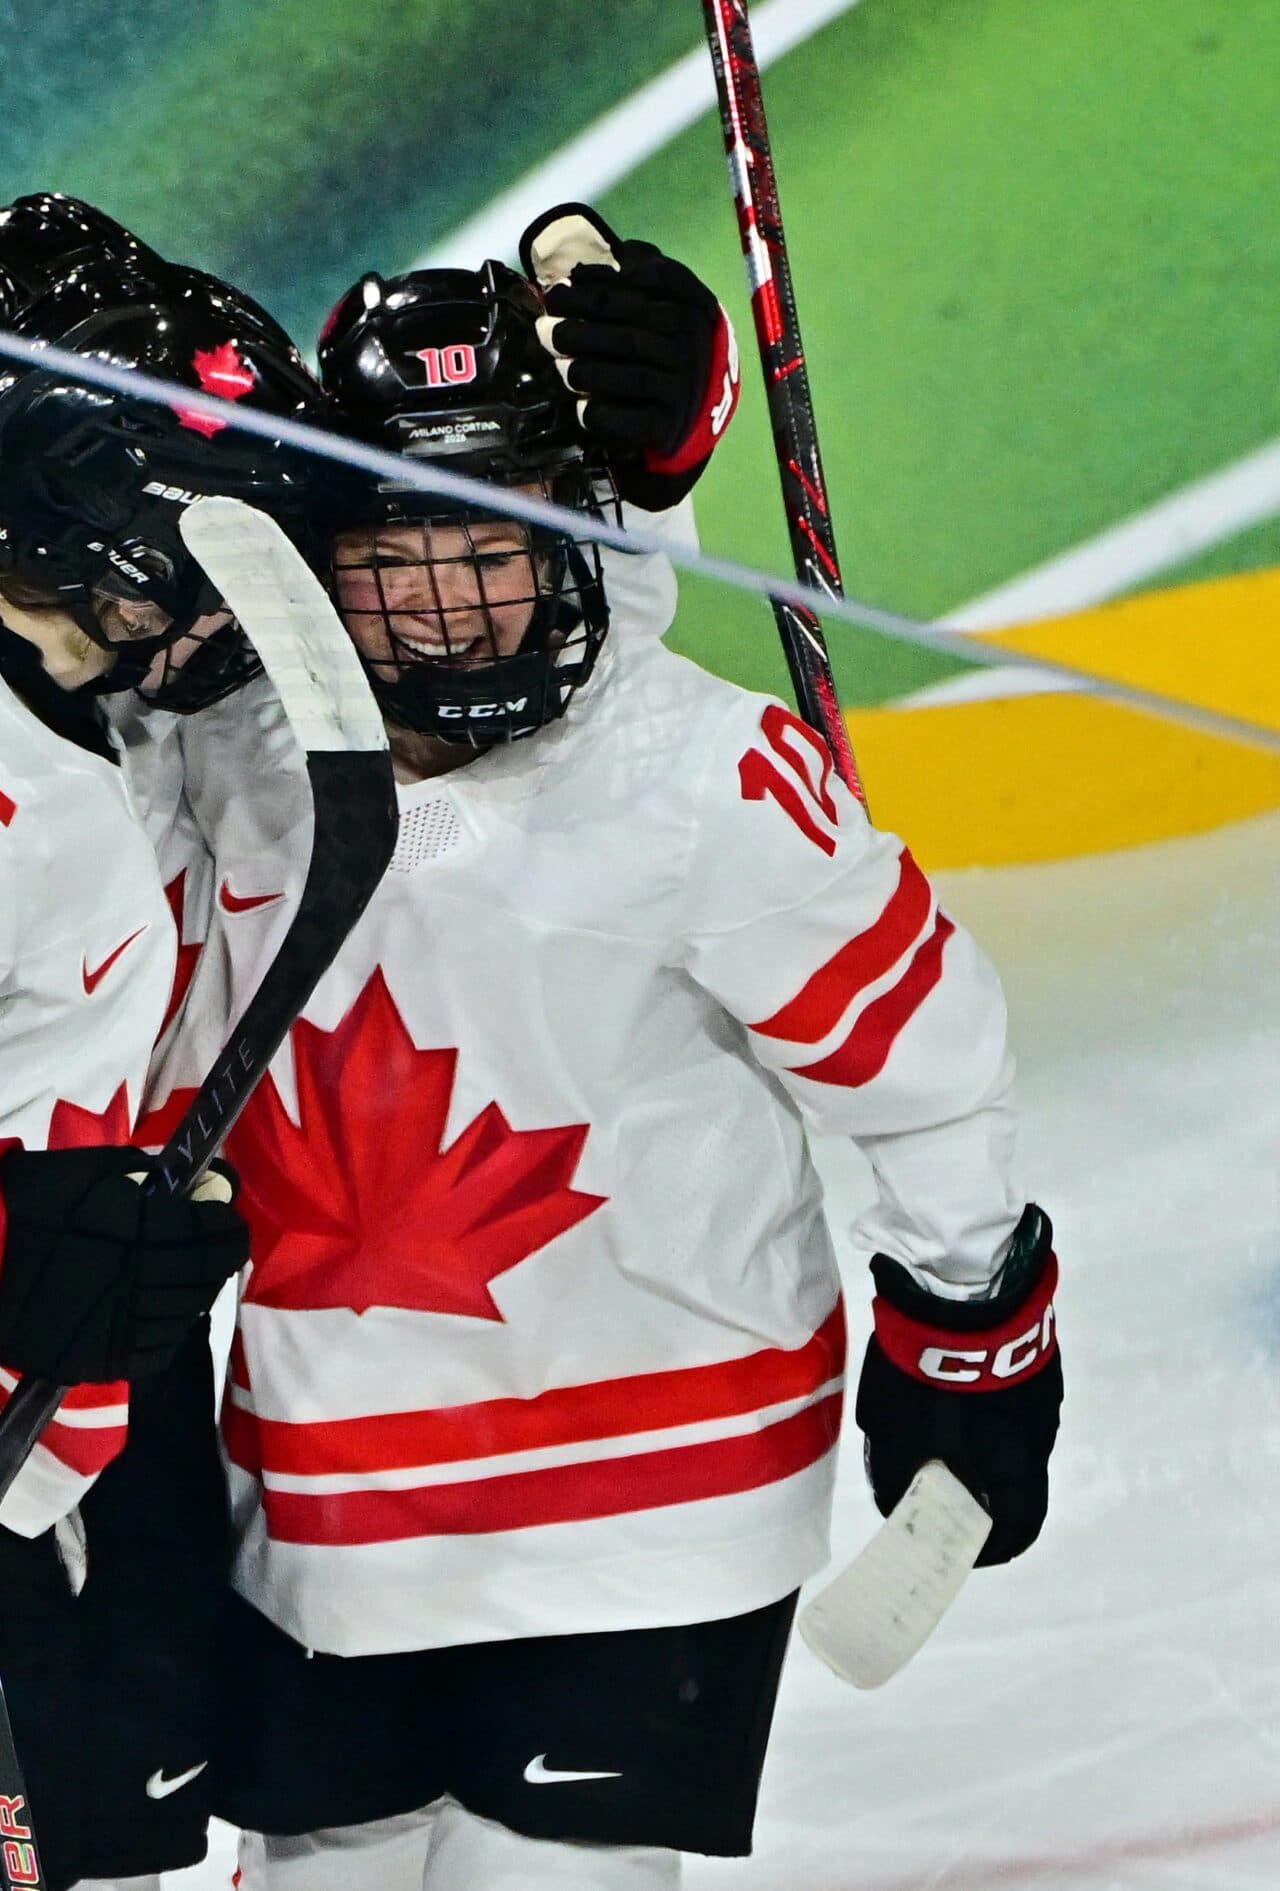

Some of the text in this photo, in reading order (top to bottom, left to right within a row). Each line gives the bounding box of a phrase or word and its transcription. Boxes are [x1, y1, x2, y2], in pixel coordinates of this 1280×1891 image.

[417, 344, 476, 387] 10
[408, 421, 502, 440] MILANO CORTINA
[140, 481, 203, 505] BAU
[86, 541, 151, 584] BUER
[437, 696, 527, 719] CCM
[736, 703, 840, 859] 10
